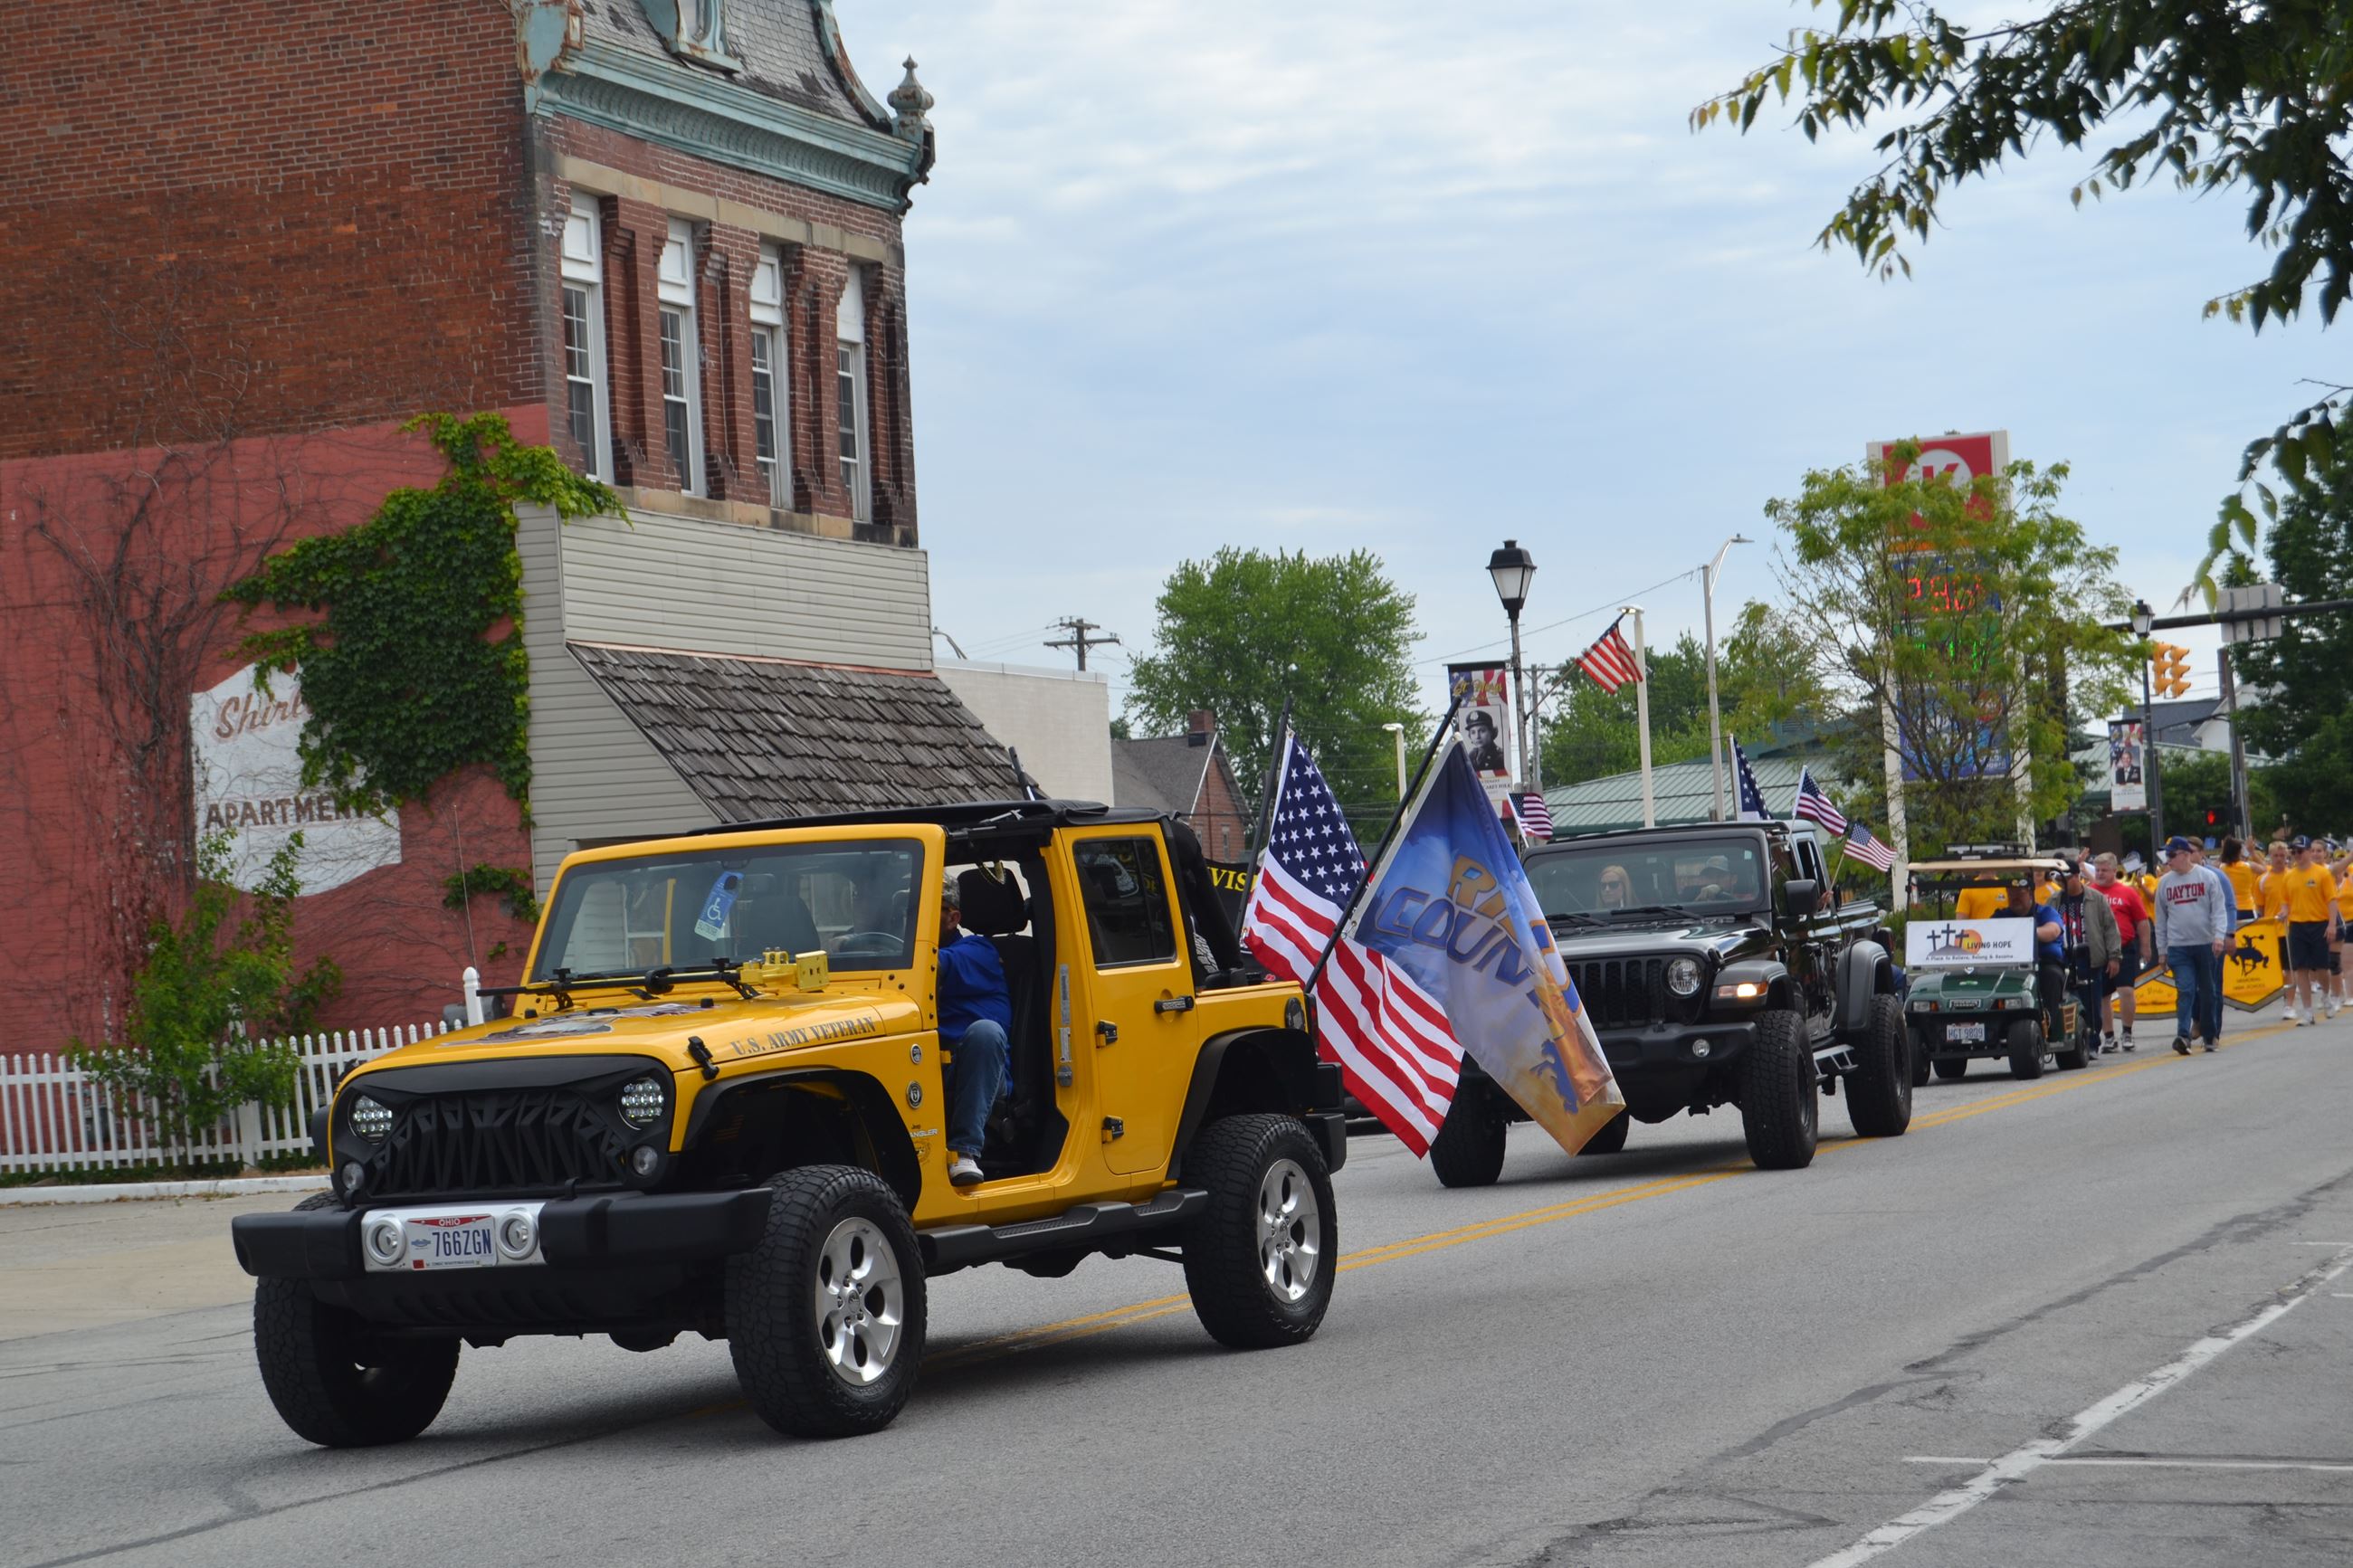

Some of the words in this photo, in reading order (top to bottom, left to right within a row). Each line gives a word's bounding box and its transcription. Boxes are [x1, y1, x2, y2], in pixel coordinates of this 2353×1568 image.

[215, 688, 313, 738] Shirl
[2167, 882, 2205, 901] DAYTON
[1967, 941, 1991, 950] LIVING
[1993, 940, 2012, 949] HOPE
[730, 1037, 766, 1056] U.S.
[767, 1027, 810, 1050] ARMY
[809, 1016, 876, 1041] VETERAN
[439, 1218, 460, 1227] OHIO
[432, 1229, 492, 1258] 766ZGN
